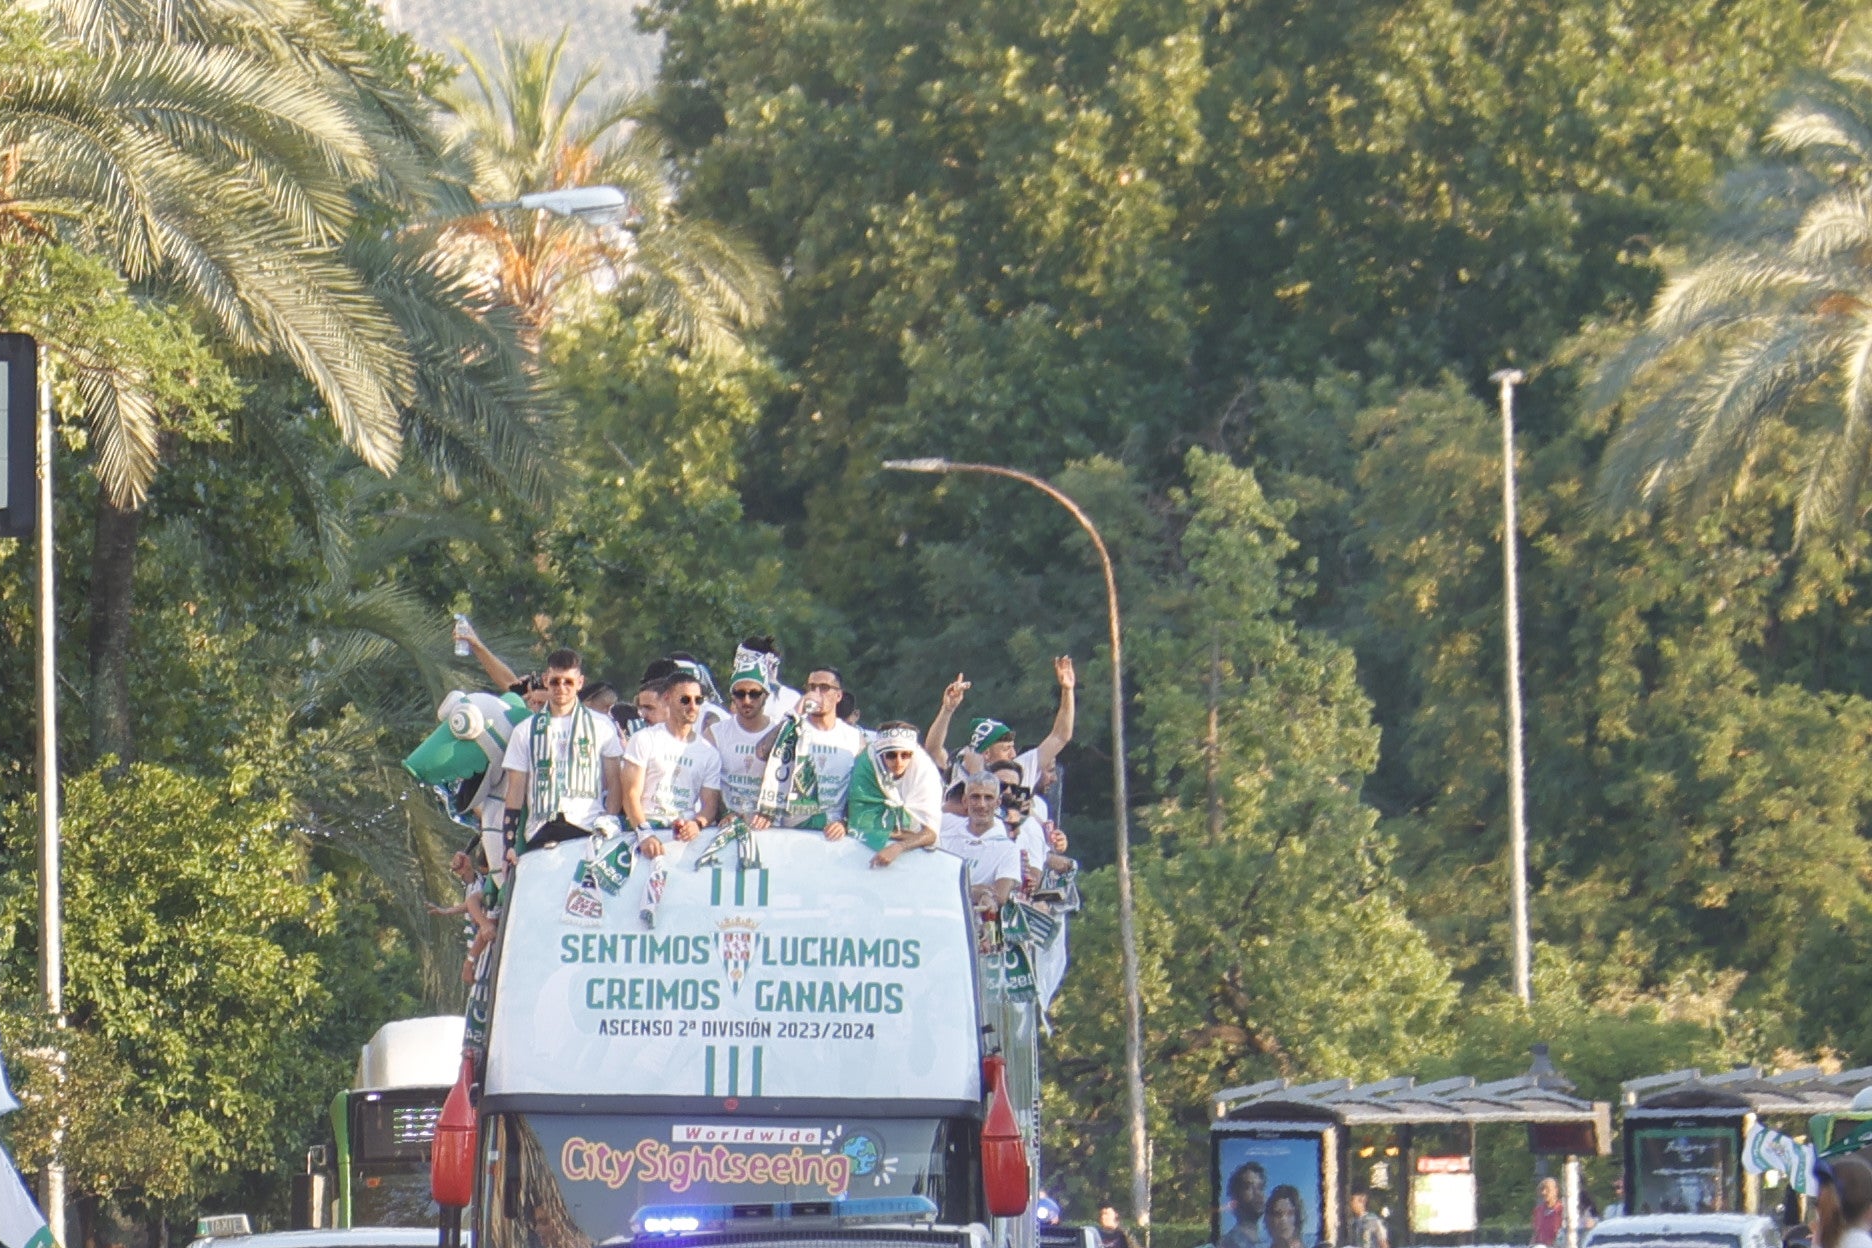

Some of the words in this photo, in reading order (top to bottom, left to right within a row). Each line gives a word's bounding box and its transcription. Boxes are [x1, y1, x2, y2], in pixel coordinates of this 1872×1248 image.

[560, 934, 711, 966] SENTIMOS
[762, 936, 921, 969] LUCHAMOS
[586, 978, 720, 1011] CREIMOS
[755, 979, 904, 1014] GANAMOS
[598, 1018, 673, 1038] ASCENSO
[701, 1016, 771, 1039] DIVISIÓN
[776, 1021, 876, 1040] 2023/2024
[684, 1126, 817, 1143] Worldwide
